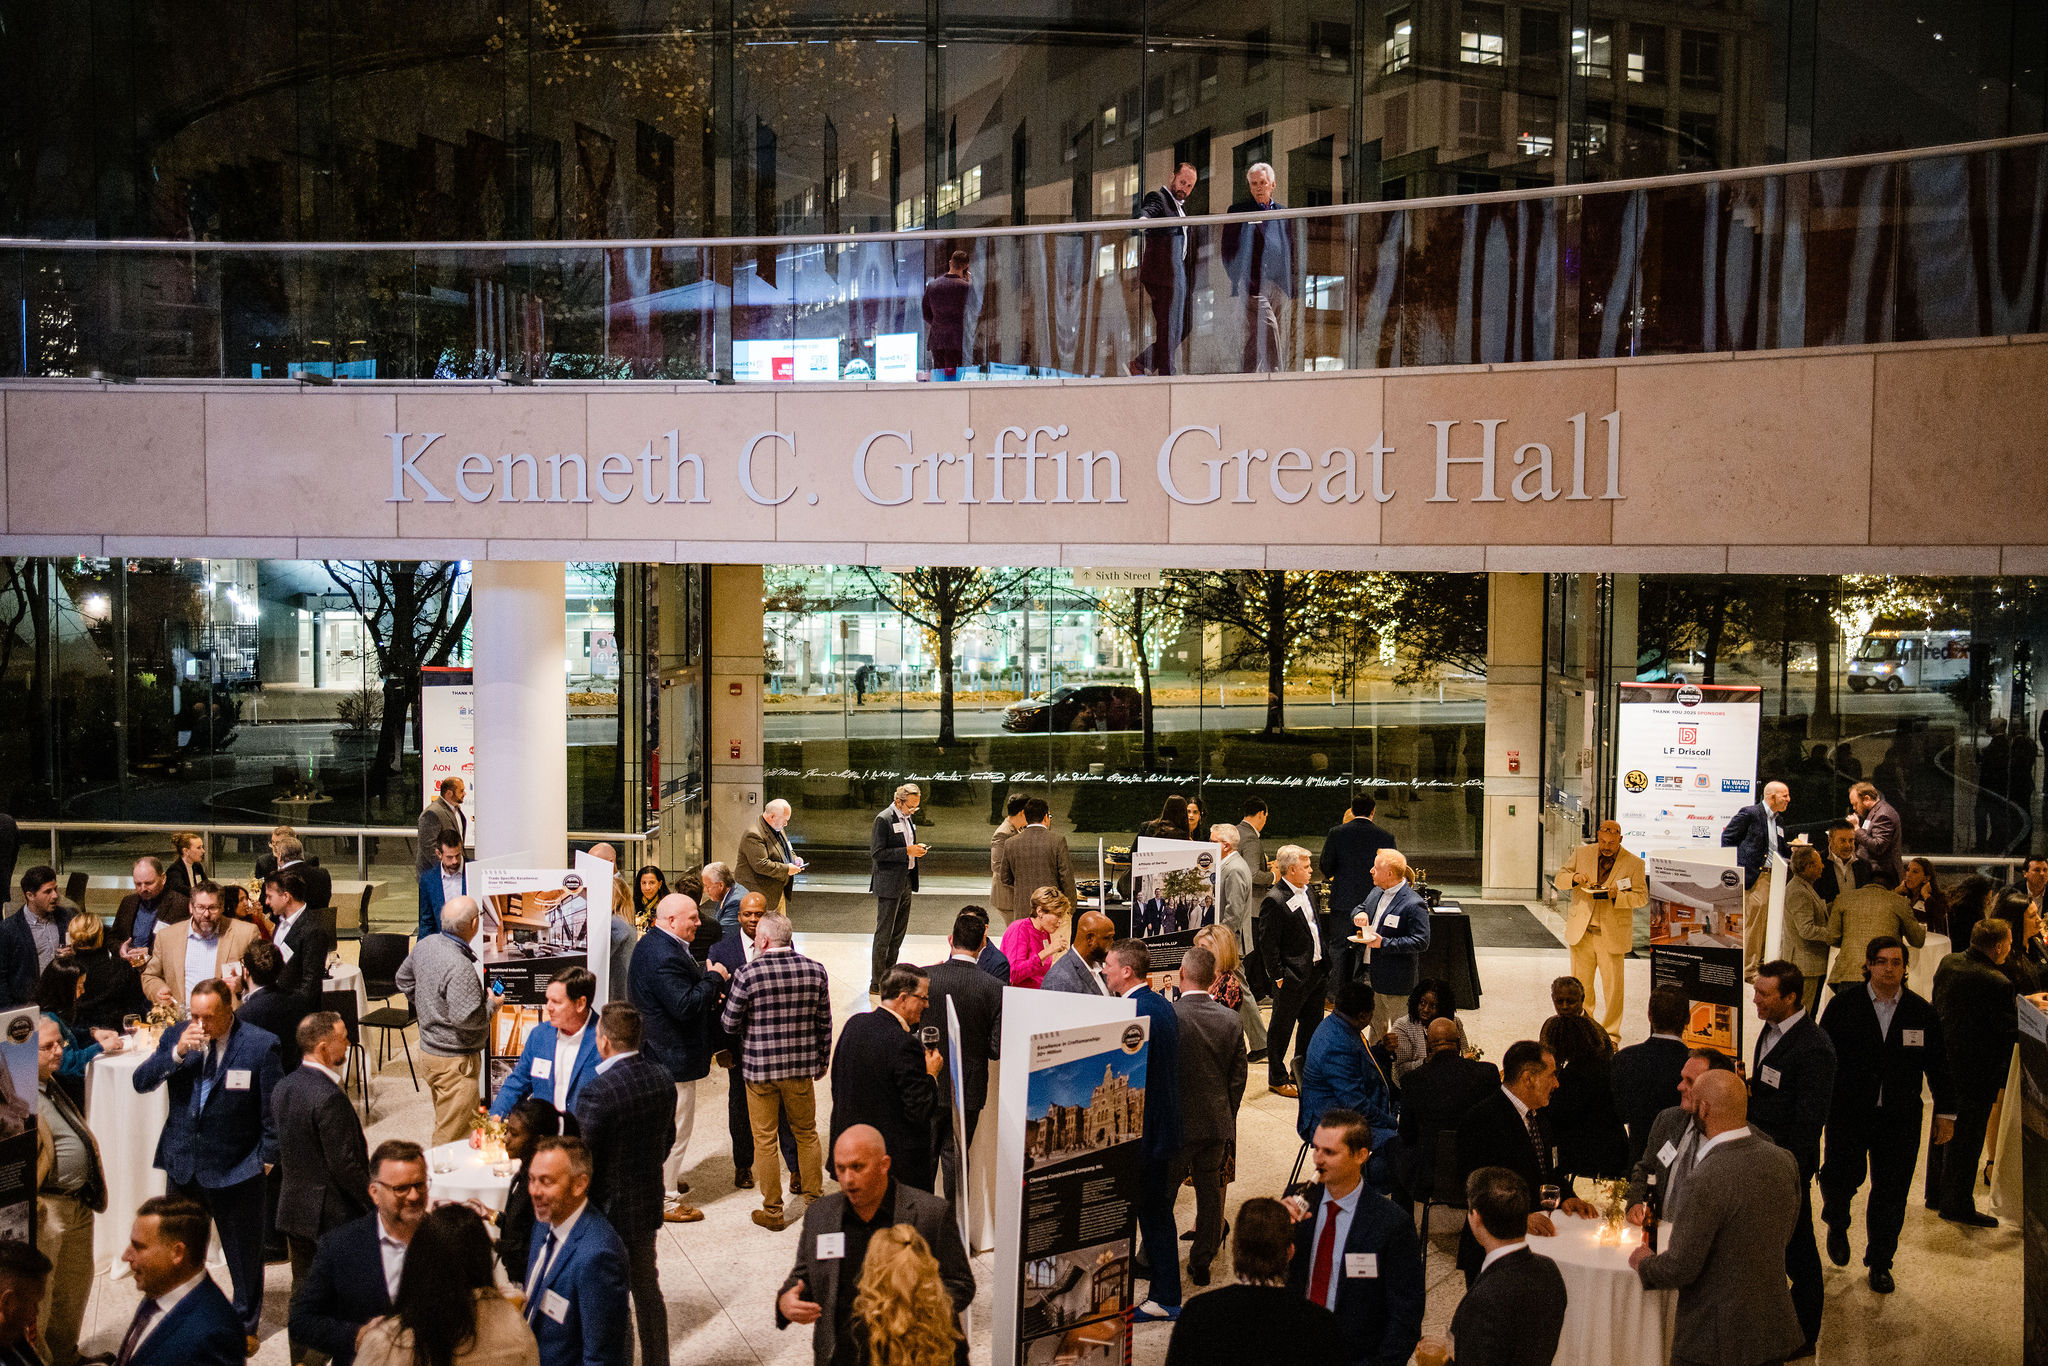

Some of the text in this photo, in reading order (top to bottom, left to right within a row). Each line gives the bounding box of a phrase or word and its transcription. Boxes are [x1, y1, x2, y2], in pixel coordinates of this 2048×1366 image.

[385, 410, 1627, 507] Kenneth C. Griffin Great Hall
[1095, 571, 1151, 580] Sixth Street
[1678, 748, 1711, 756] Driscoll
[1656, 776, 1683, 784] EPG
[1047, 1170, 1076, 1179] Construction
